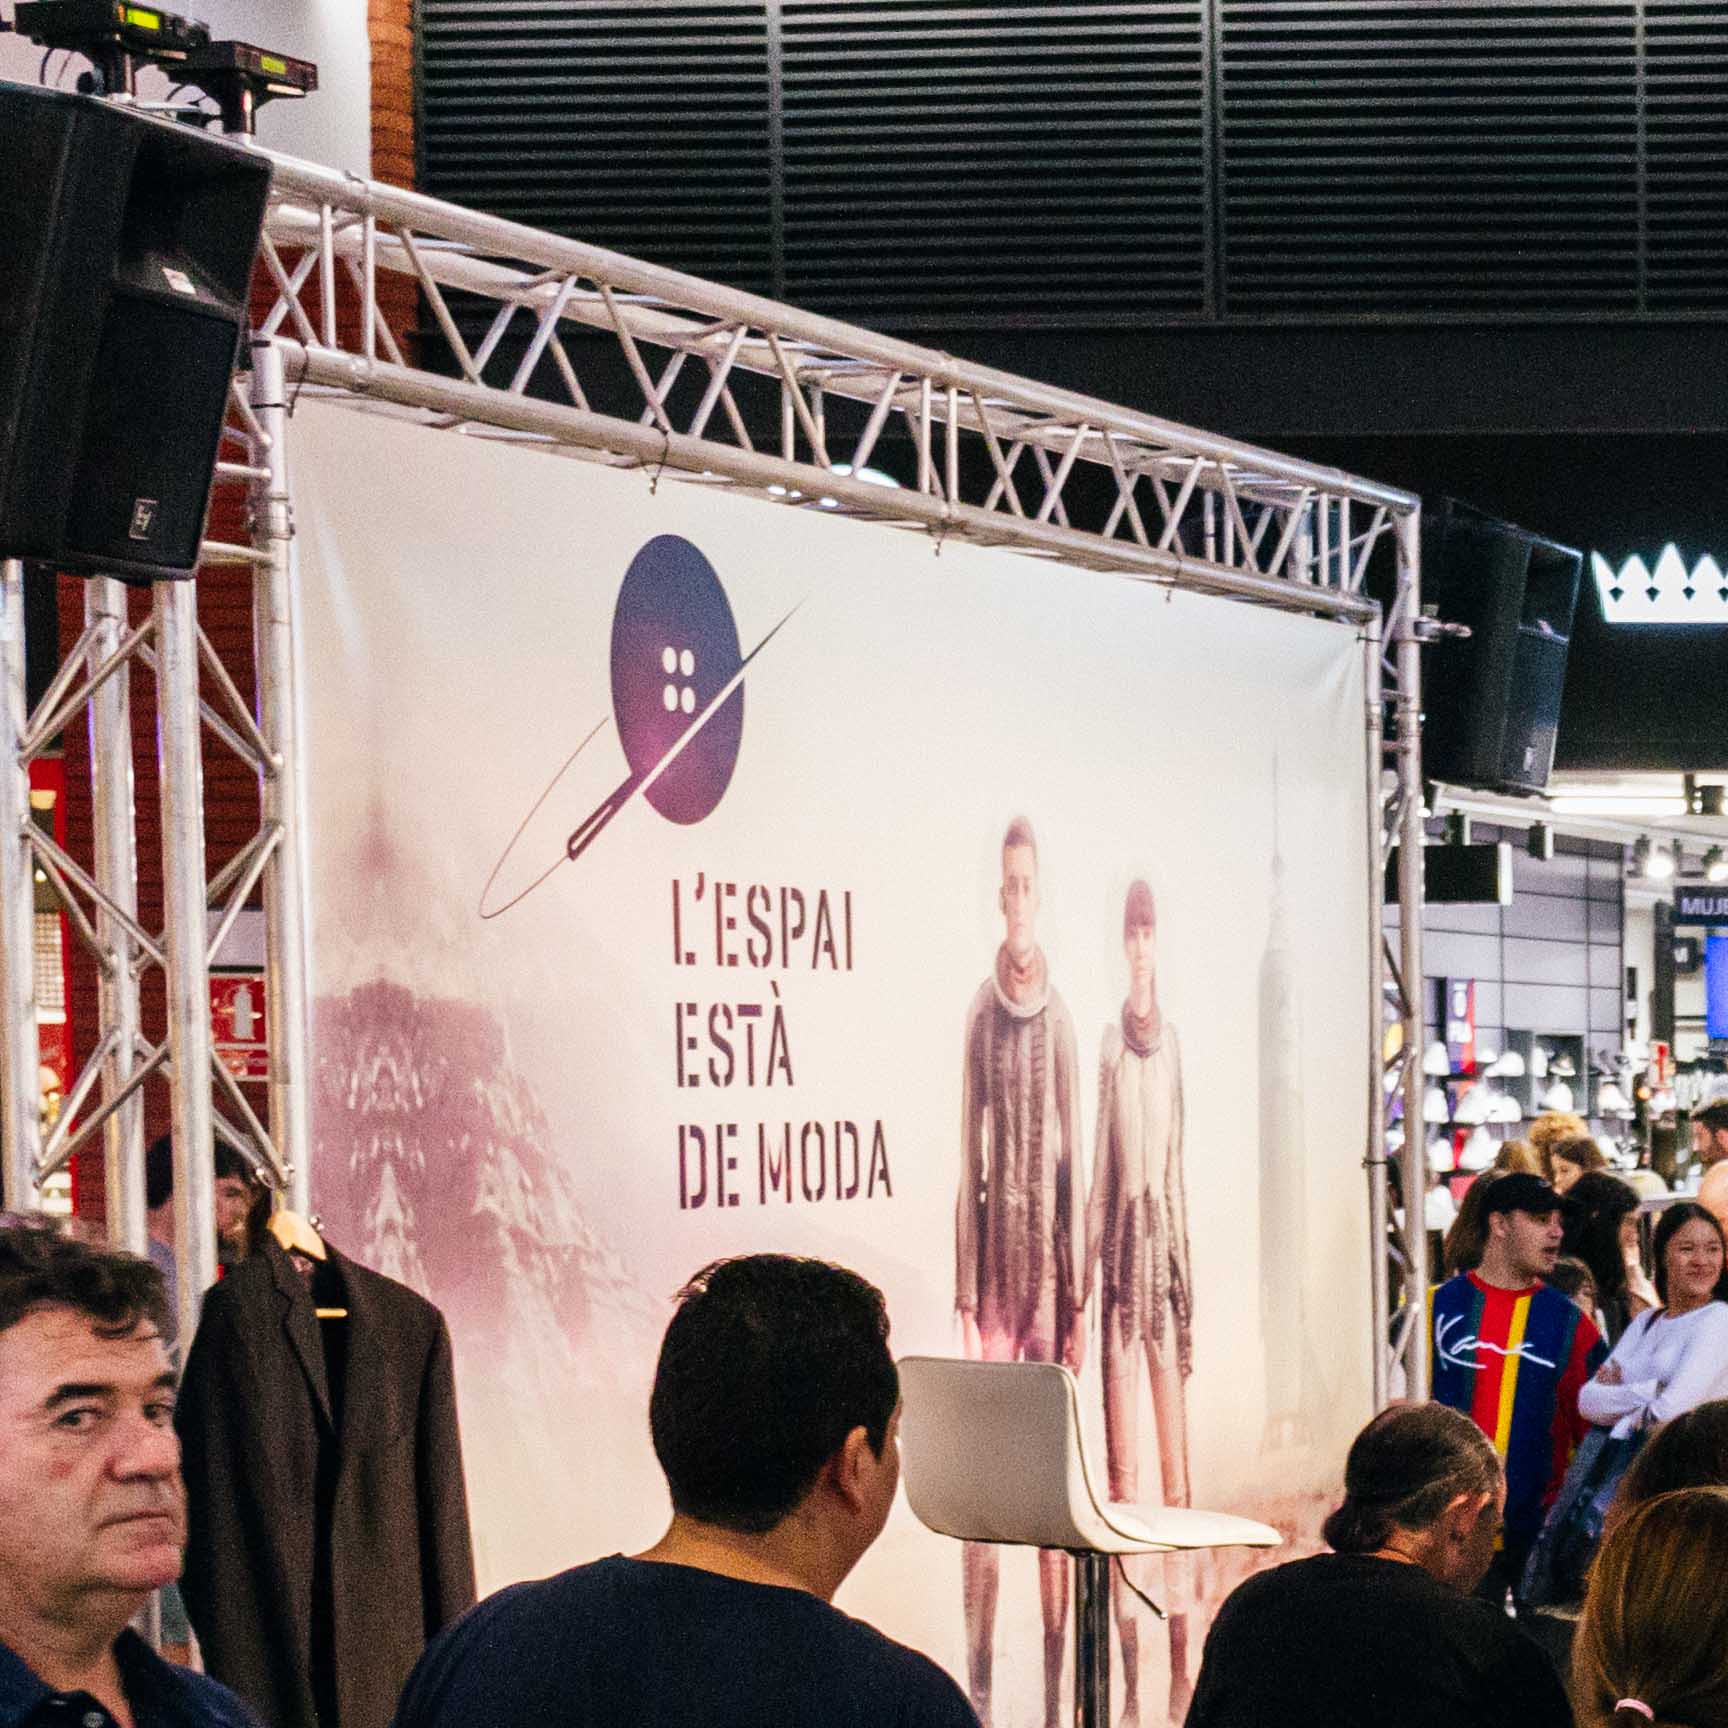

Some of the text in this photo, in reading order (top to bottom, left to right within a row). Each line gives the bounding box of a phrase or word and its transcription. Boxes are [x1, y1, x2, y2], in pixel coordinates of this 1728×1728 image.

[672, 870, 853, 971] L'ESPAI
[675, 980, 794, 1088] ESTÀ
[678, 1119, 893, 1211] DE MODA
